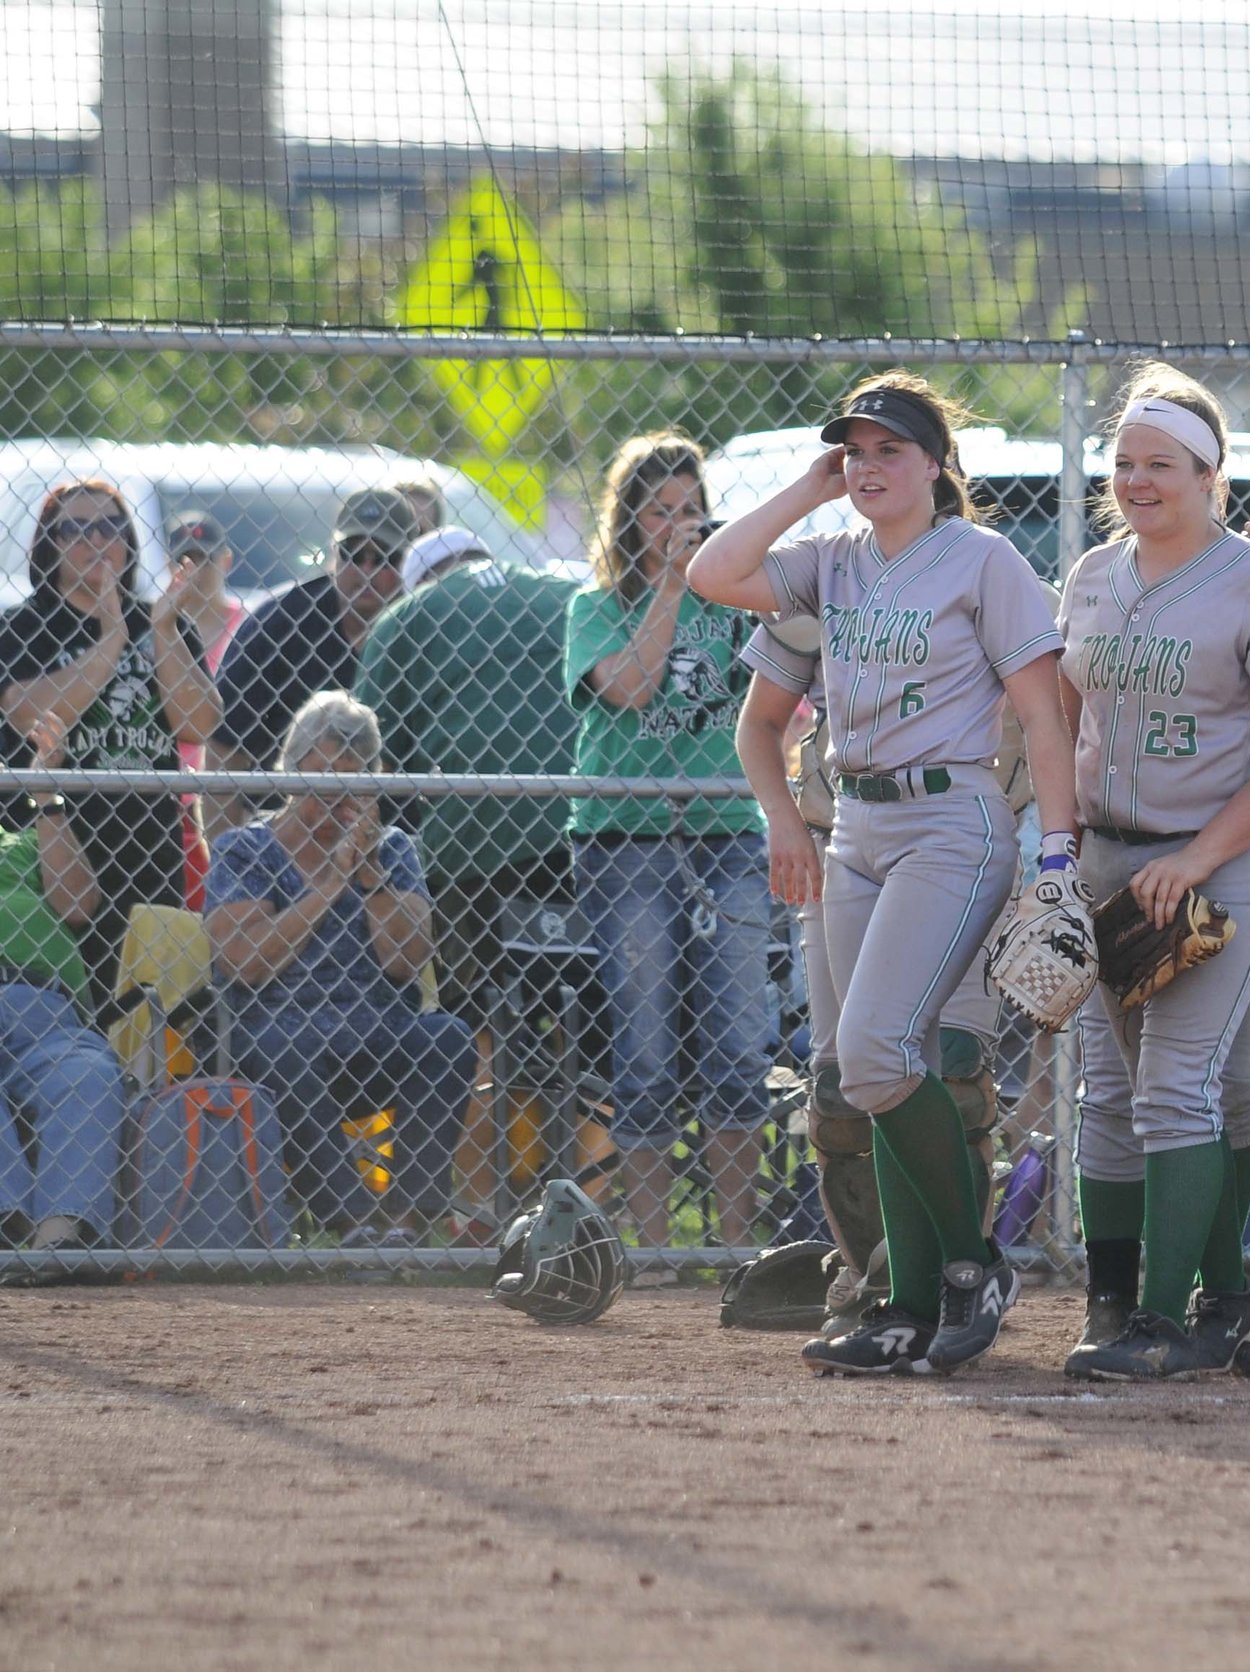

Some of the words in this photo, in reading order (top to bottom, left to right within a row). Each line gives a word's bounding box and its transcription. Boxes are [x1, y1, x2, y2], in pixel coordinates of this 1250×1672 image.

[1079, 631, 1193, 698] TROJANS
[899, 680, 928, 720] 6
[1144, 709, 1199, 757] 23
